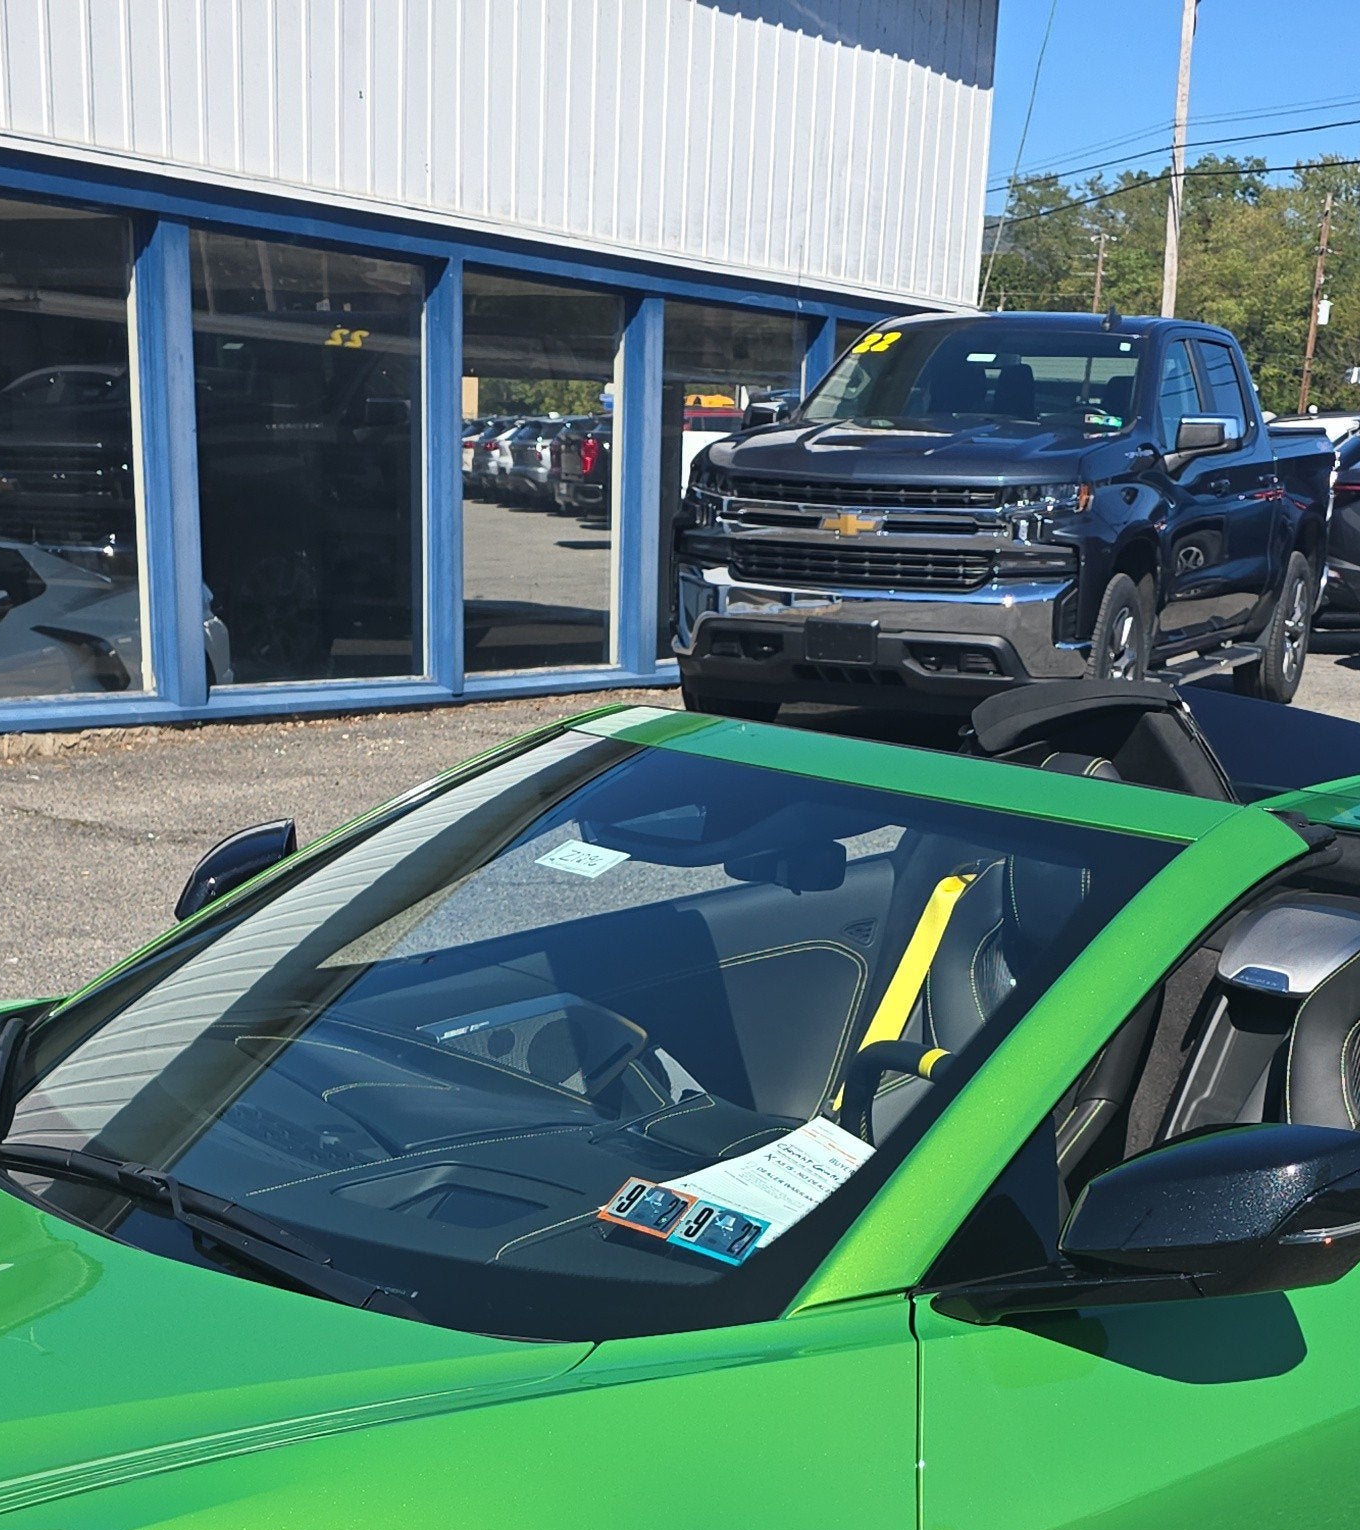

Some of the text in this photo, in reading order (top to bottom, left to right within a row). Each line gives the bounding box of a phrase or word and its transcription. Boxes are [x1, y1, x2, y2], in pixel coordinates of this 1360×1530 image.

[851, 331, 902, 355] 22
[616, 1184, 647, 1213] 9
[684, 1207, 763, 1256] 9 27
